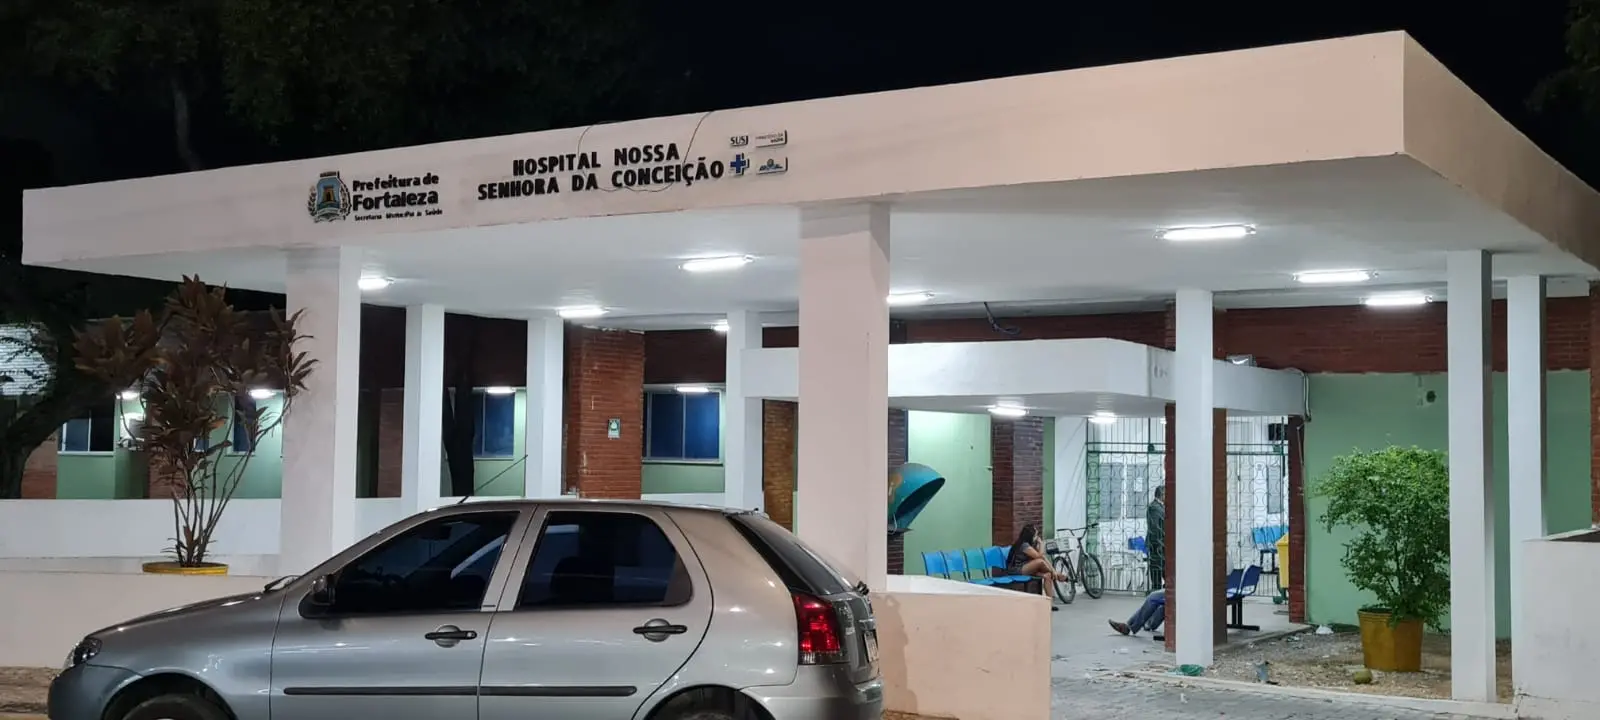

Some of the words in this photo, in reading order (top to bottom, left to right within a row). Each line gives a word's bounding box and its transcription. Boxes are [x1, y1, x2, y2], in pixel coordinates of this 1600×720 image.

[513, 151, 601, 177] HOSPITAL
[614, 143, 680, 166] NOSSA
[352, 174, 421, 192] Prefeitura
[422, 172, 440, 185] de
[477, 176, 560, 200] SENHORA
[571, 172, 599, 192] DA
[611, 157, 724, 188] CONCEIÇÃO
[352, 190, 439, 211] Fortaleza
